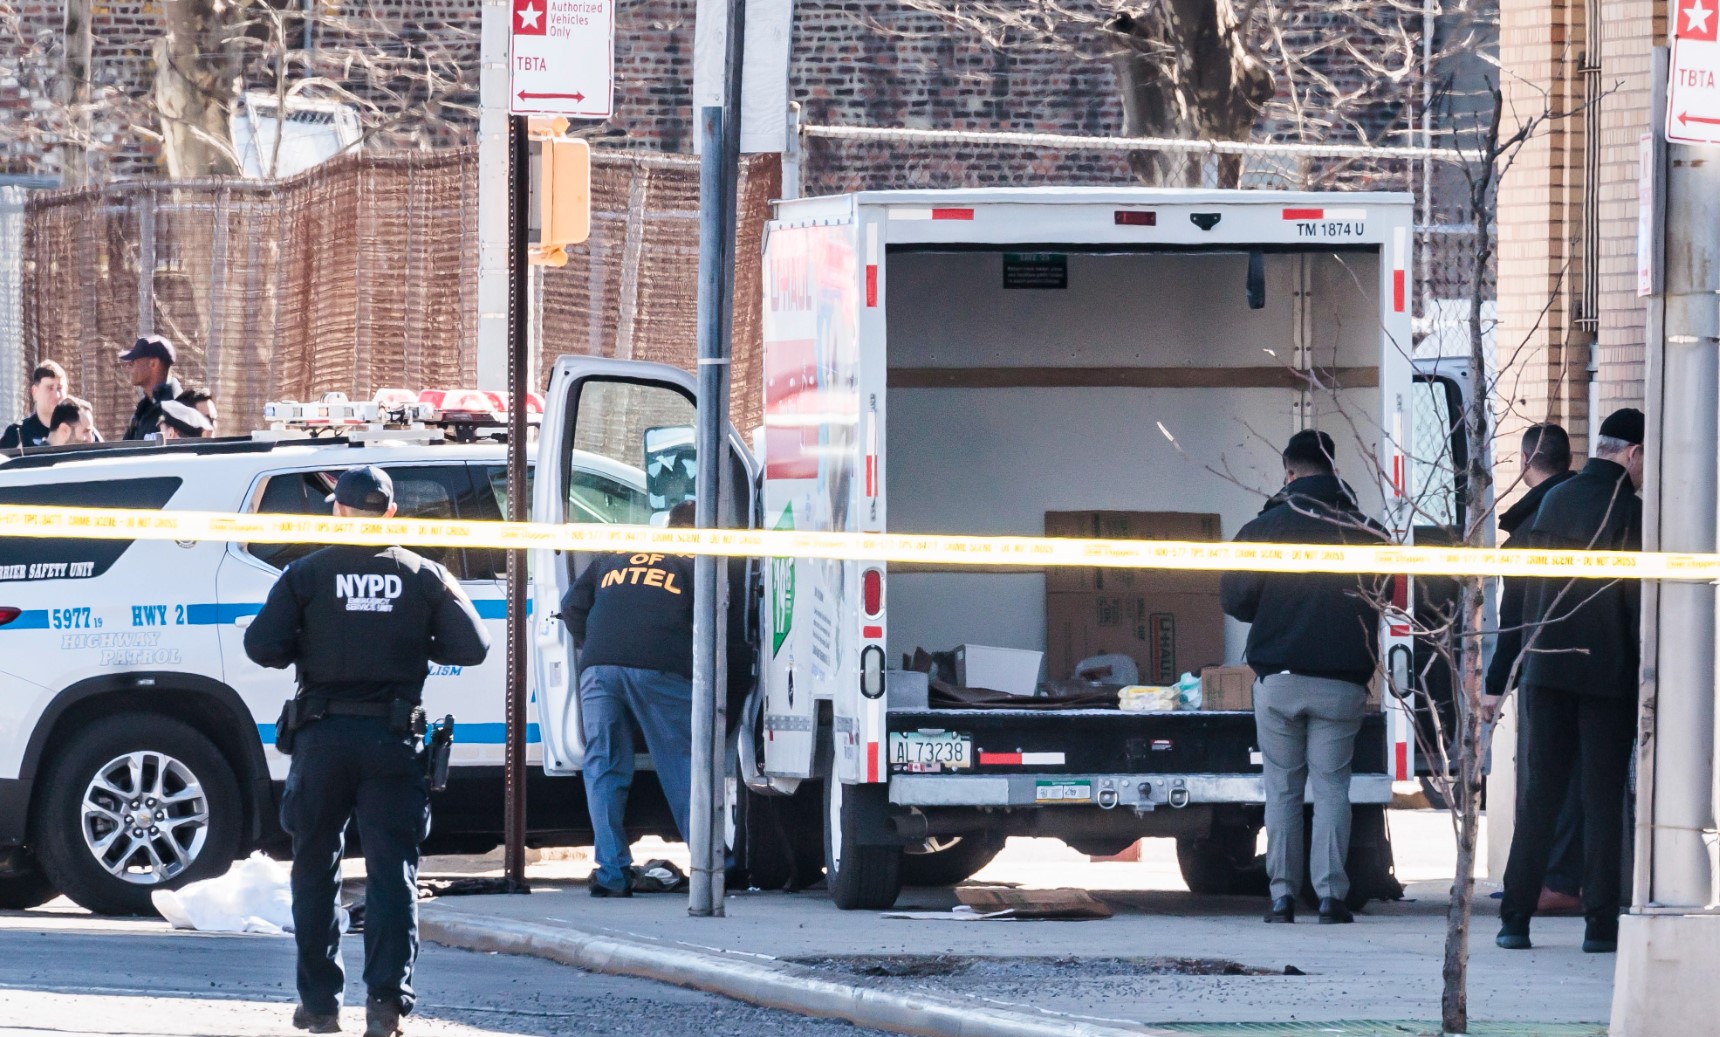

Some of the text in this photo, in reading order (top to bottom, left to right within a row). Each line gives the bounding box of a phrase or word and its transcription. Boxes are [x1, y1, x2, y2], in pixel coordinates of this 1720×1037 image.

[551, 1, 603, 13] Authorized
[551, 13, 589, 26] Vehicles
[550, 25, 571, 39] Only
[516, 56, 547, 71] TBTA
[1679, 68, 1715, 89] TBTA
[1296, 222, 1364, 237] TM 1874 U
[629, 553, 665, 566] OF
[28, 563, 68, 579] SAFETY
[69, 561, 95, 577] UNIT
[336, 573, 403, 599] NYPD
[601, 566, 682, 595] INTEL
[52, 606, 103, 630] 5977 19
[131, 604, 185, 627] HWY 2
[61, 631, 162, 650] HIGHWAY
[99, 648, 182, 667] PATROL
